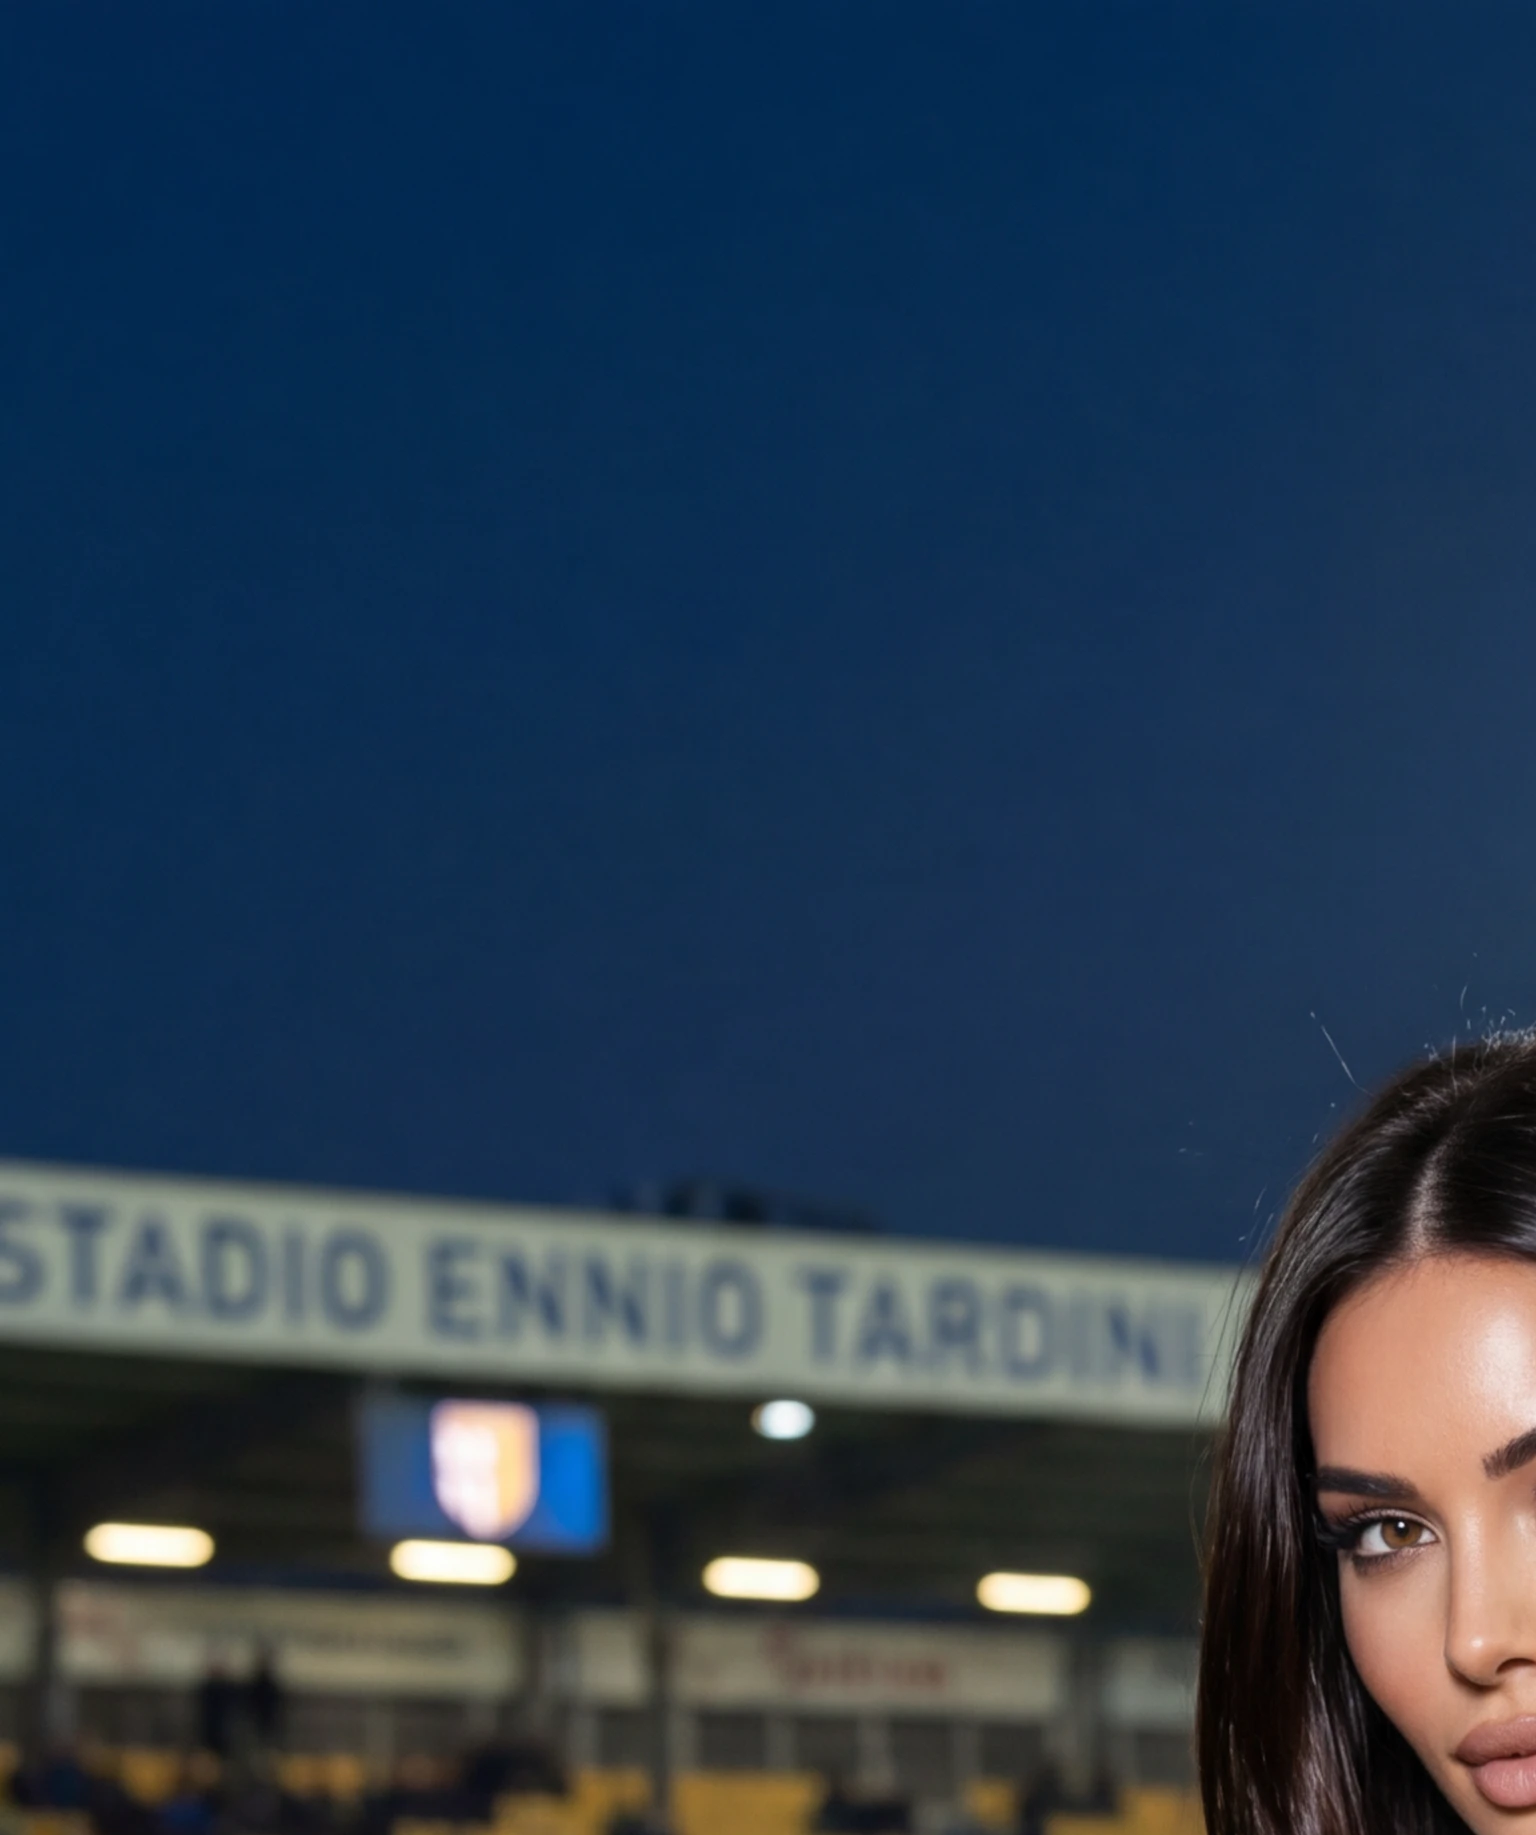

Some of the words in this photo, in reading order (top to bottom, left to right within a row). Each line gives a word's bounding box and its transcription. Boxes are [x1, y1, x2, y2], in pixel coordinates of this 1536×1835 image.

[0, 1197, 390, 1330] STADIO
[427, 1233, 765, 1360] ENNIO
[797, 1262, 1206, 1389] TARDINI
